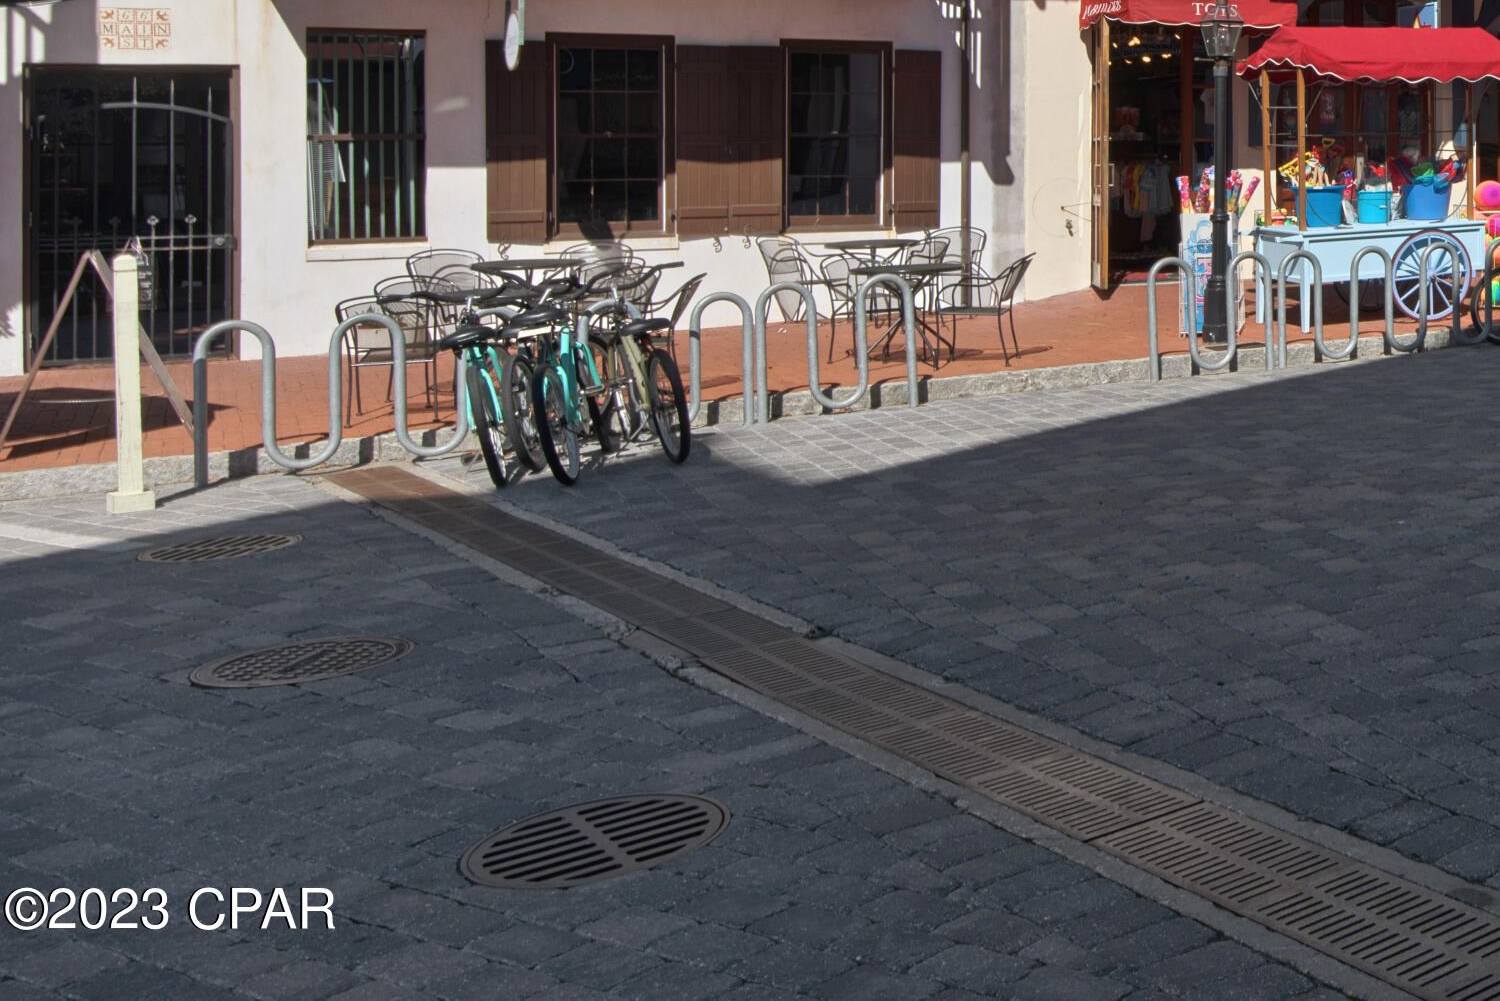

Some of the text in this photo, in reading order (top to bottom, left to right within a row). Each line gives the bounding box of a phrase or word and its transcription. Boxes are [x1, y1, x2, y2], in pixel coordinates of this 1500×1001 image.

[121, 10, 148, 20] 66
[103, 24, 168, 34] MAIN
[122, 38, 150, 48] ST
